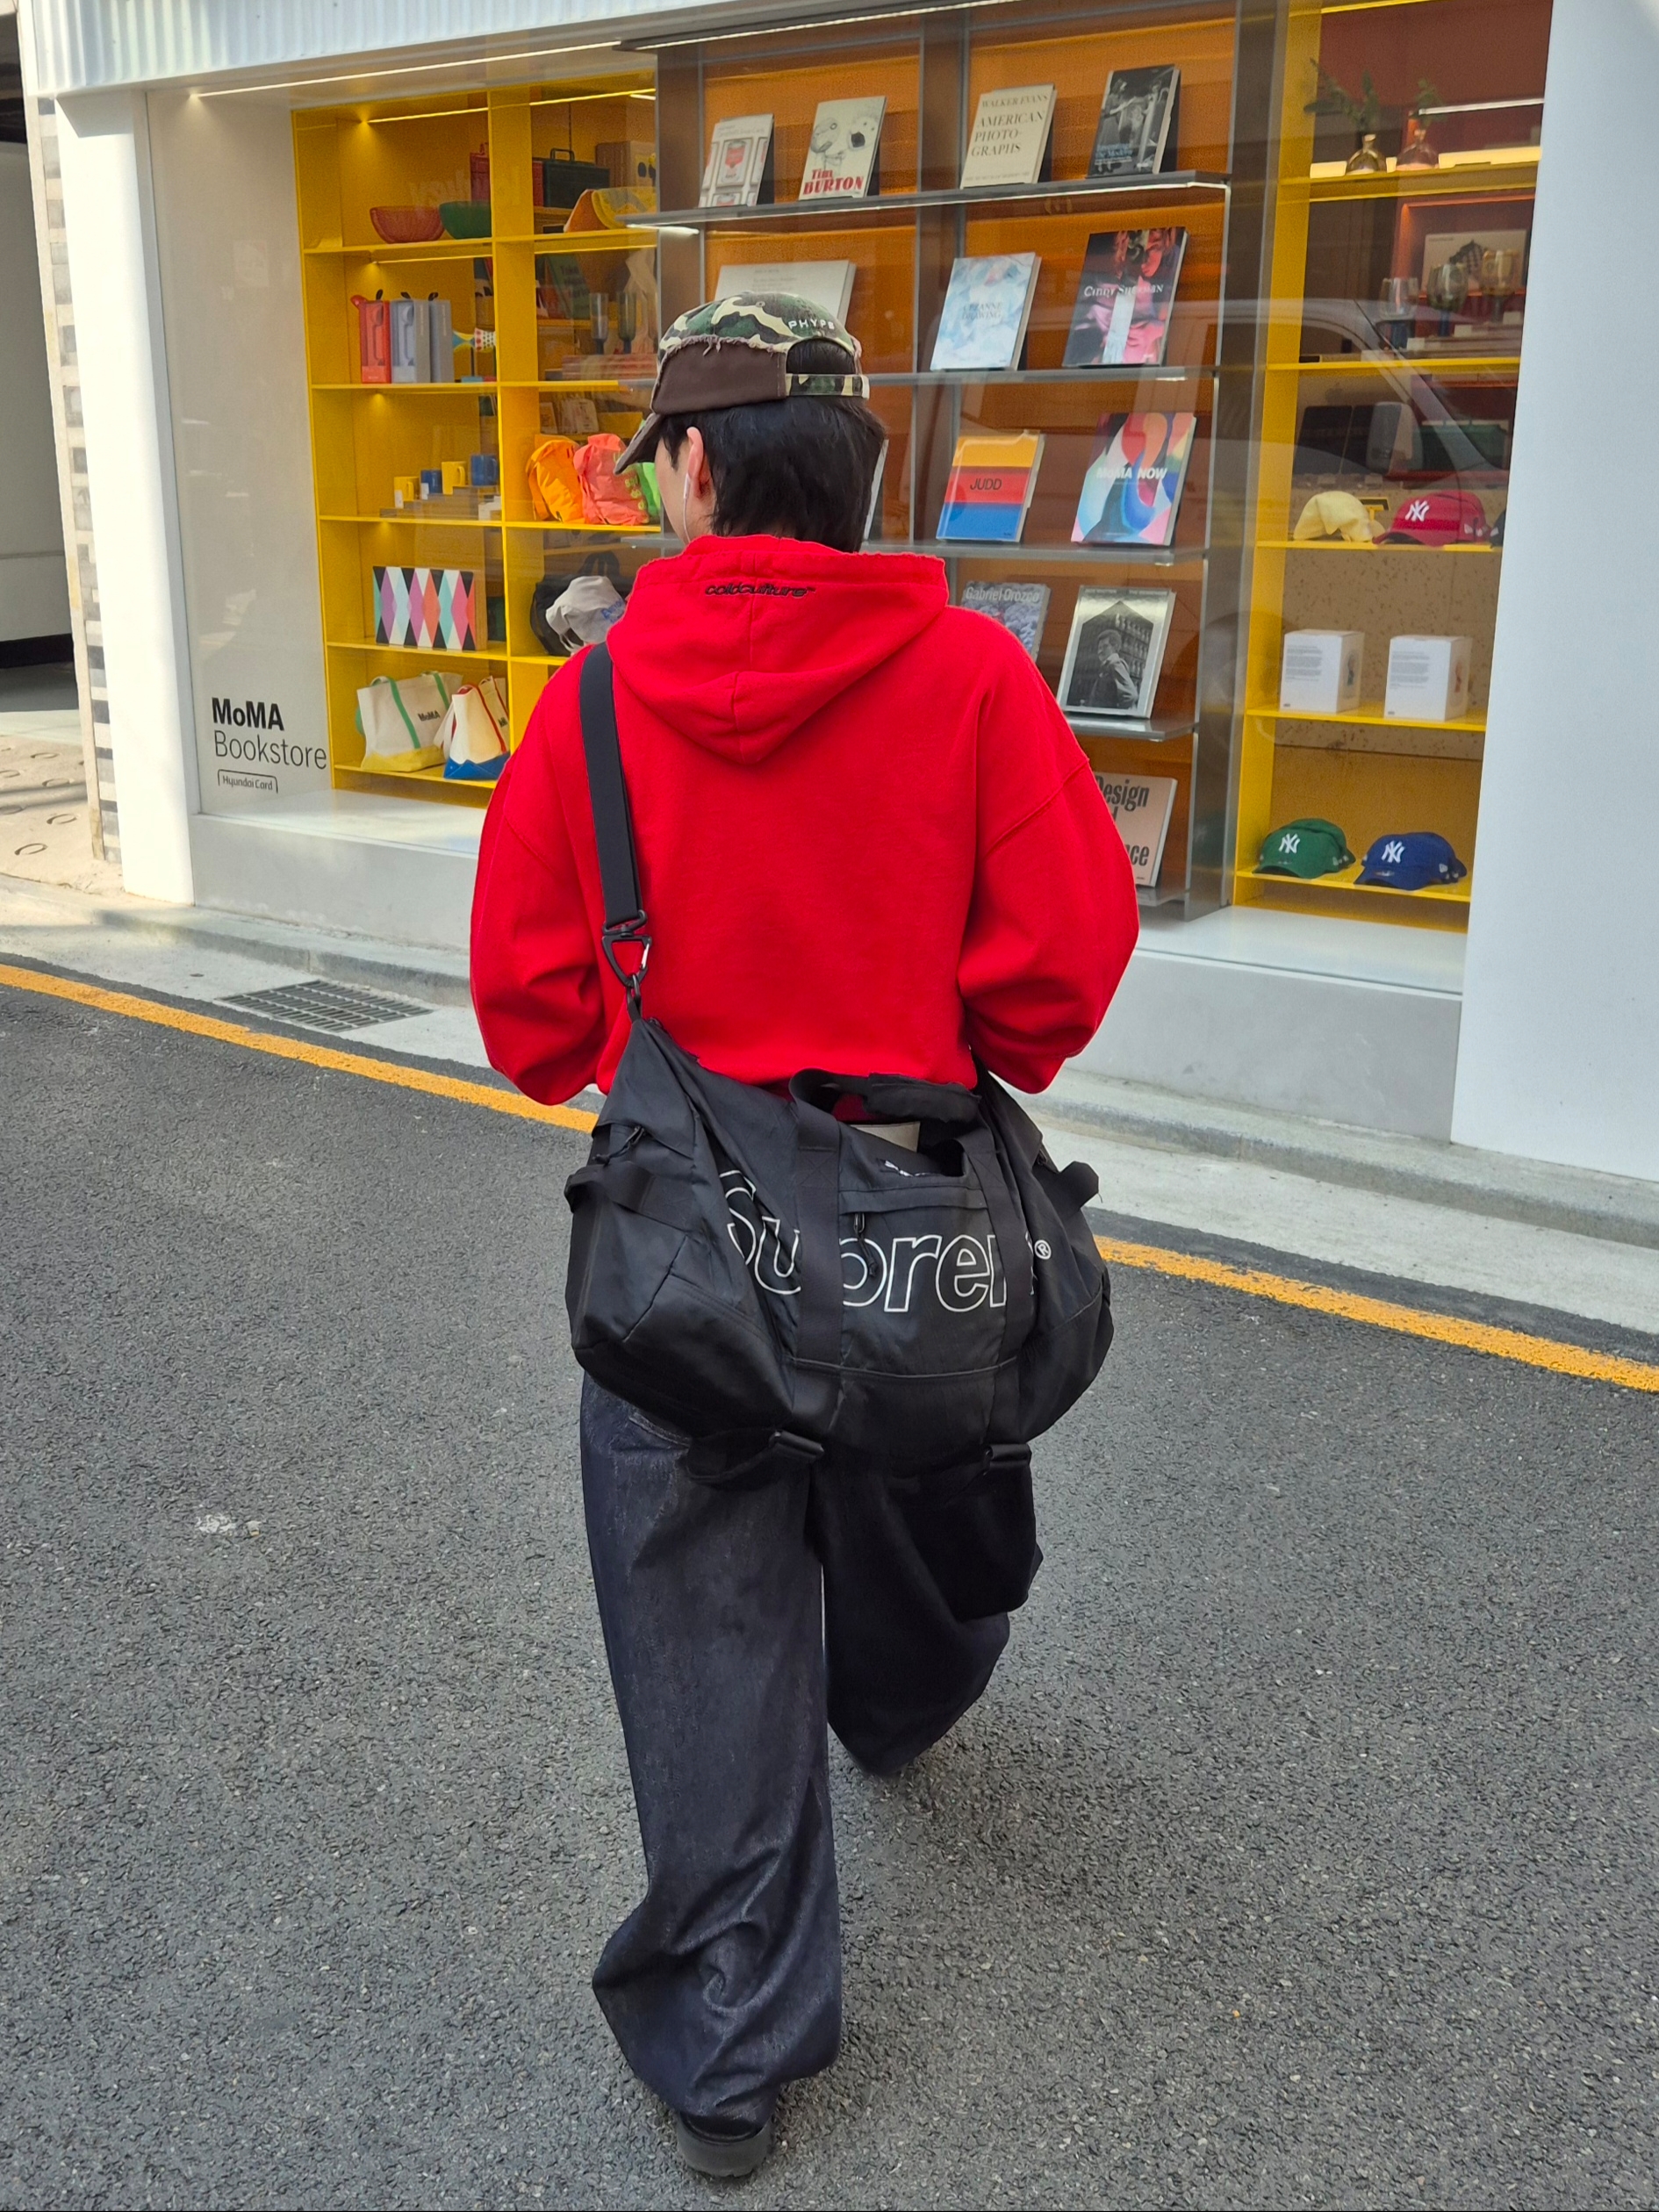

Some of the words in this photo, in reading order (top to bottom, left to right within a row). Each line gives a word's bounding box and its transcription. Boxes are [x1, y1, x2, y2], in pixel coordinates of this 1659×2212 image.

[982, 97, 1018, 108] WALKER
[1020, 94, 1049, 104] EVANS
[977, 111, 1045, 127] AMERICAN
[971, 143, 1021, 156] GRAPHS
[811, 169, 834, 180] Tim
[802, 176, 865, 195] BURTON
[1137, 467, 1168, 479] NOW
[970, 478, 1002, 490] JUDD
[966, 586, 1002, 600] Gabriel
[1003, 588, 1040, 603] Orozco
[212, 697, 284, 731] MoMA
[214, 729, 327, 770] Bookstore
[222, 775, 254, 788] Hyundai
[255, 779, 273, 790] Card
